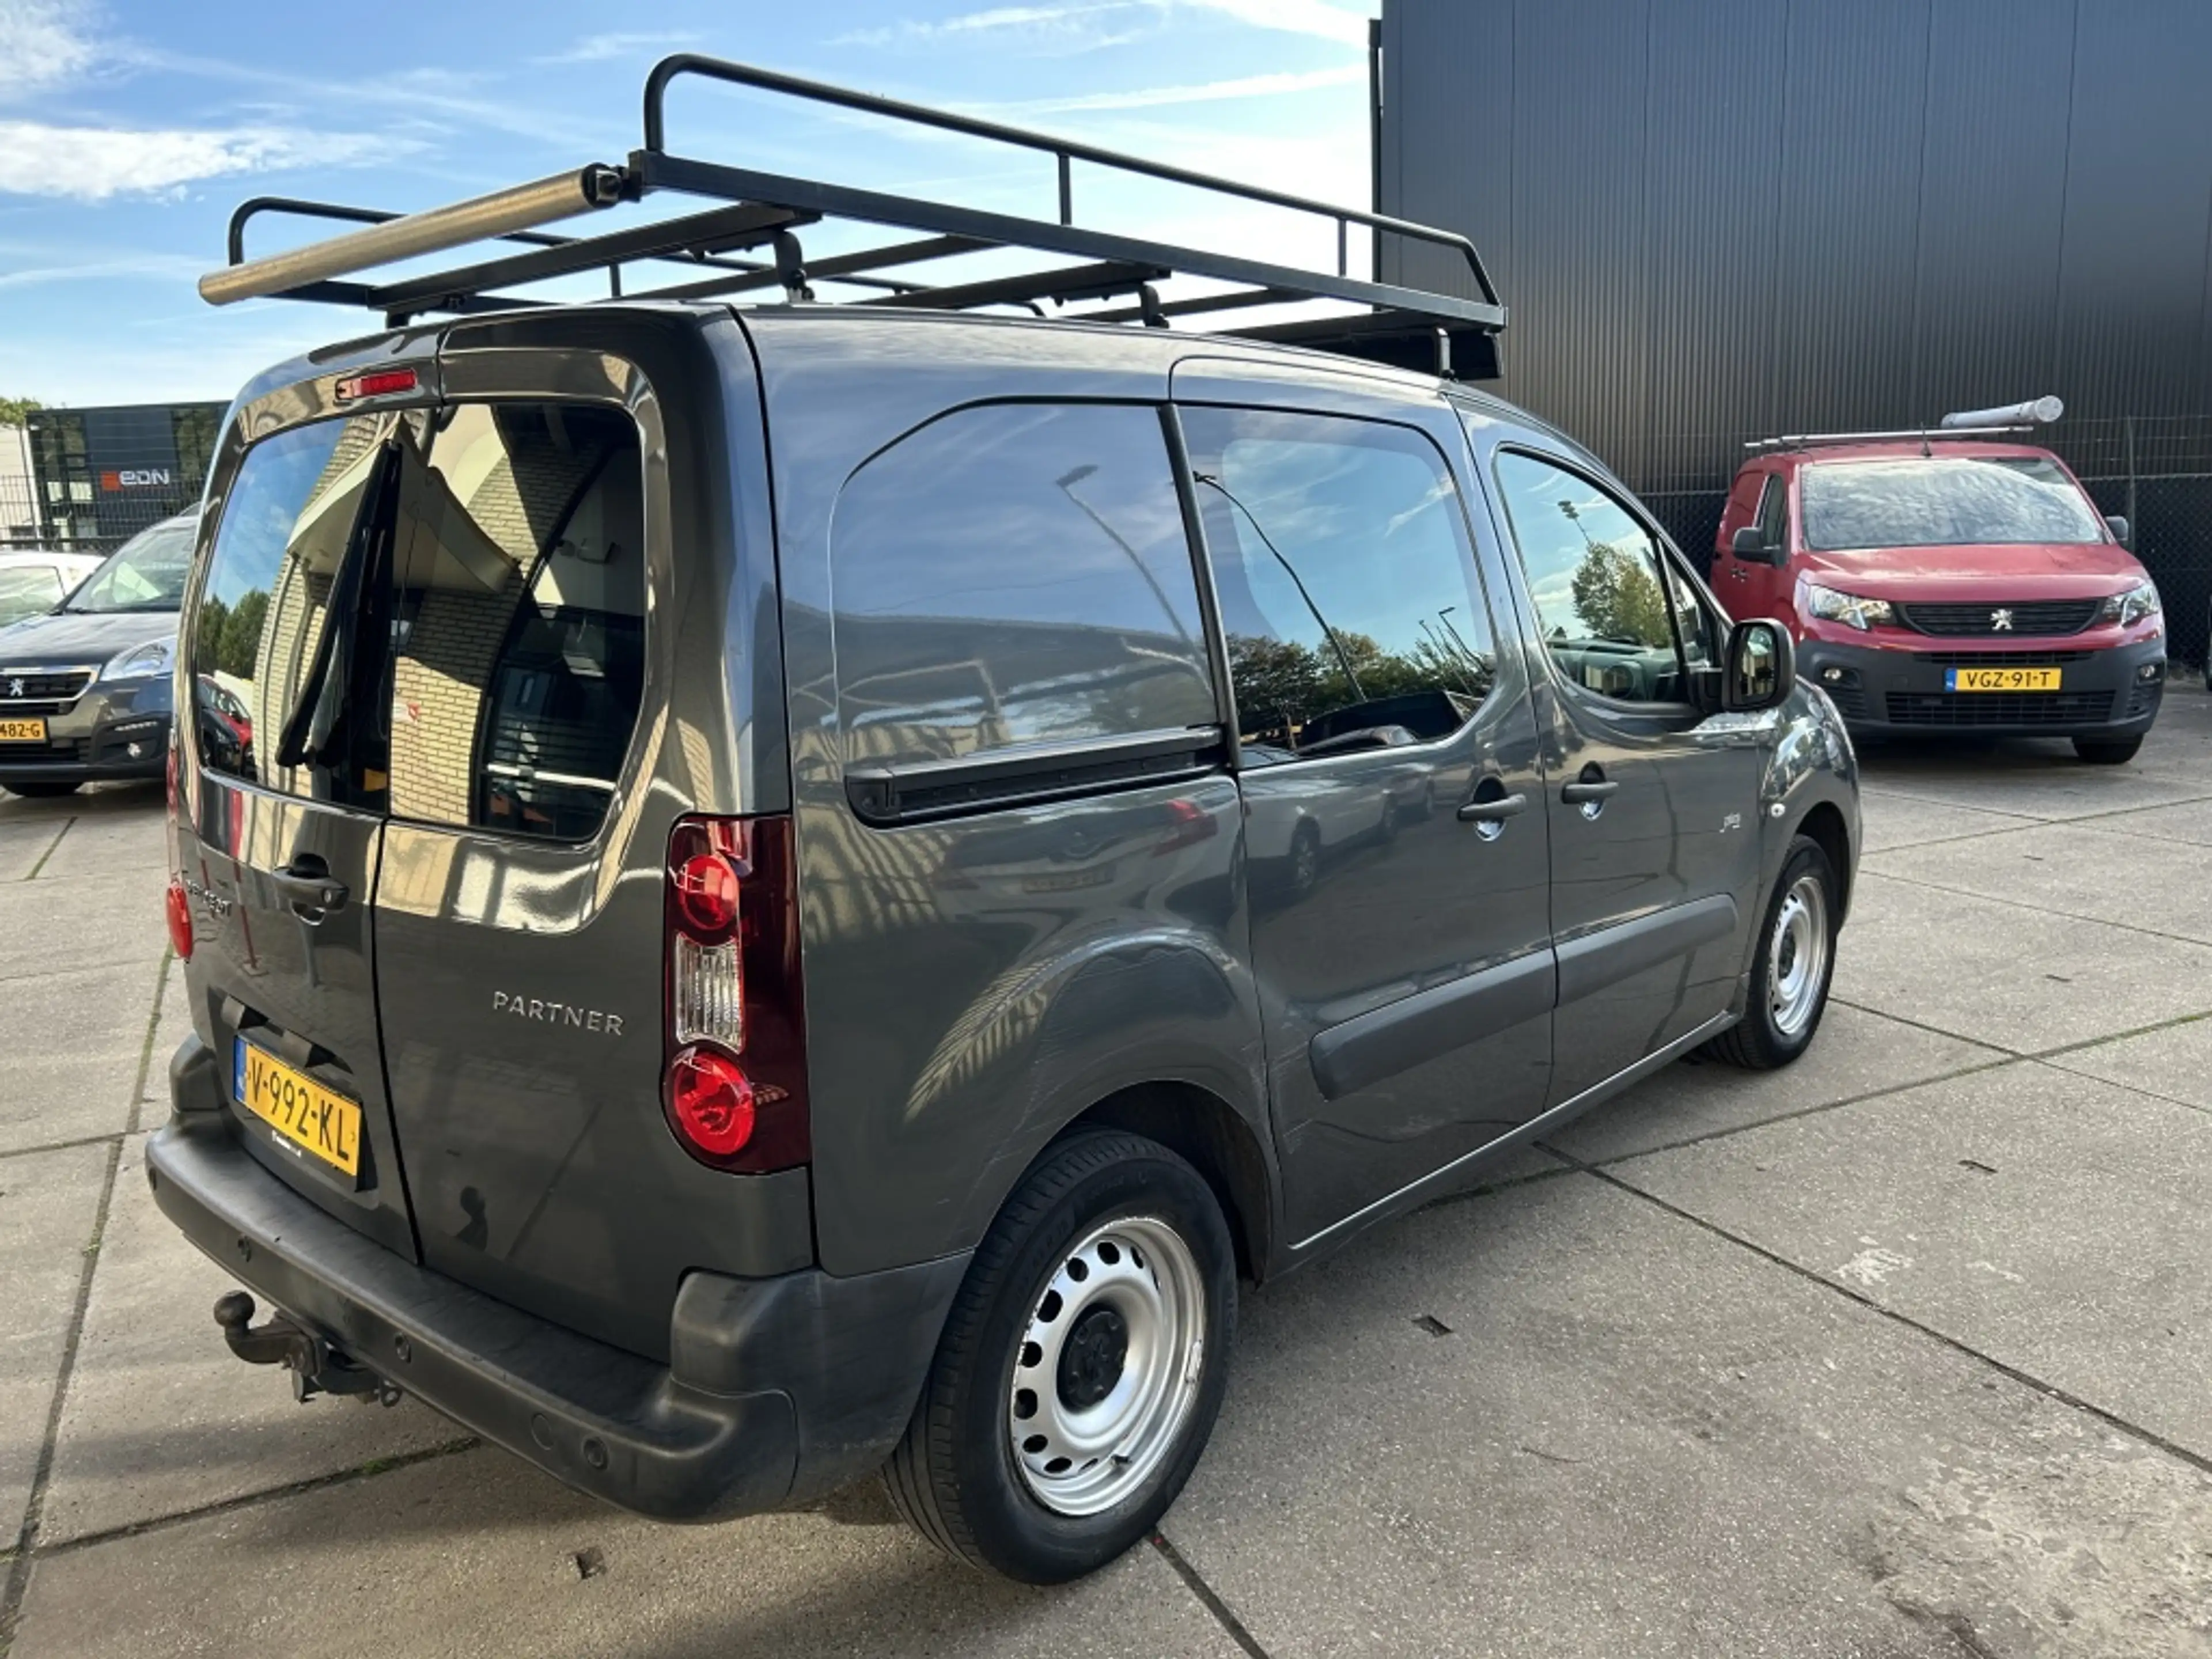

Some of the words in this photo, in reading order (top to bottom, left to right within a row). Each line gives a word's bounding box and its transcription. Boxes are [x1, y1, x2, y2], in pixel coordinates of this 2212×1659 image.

[1966, 672, 2051, 687] VGZ-91-T
[494, 991, 624, 1036] PARTNER
[251, 1056, 350, 1162] V-992-KL
